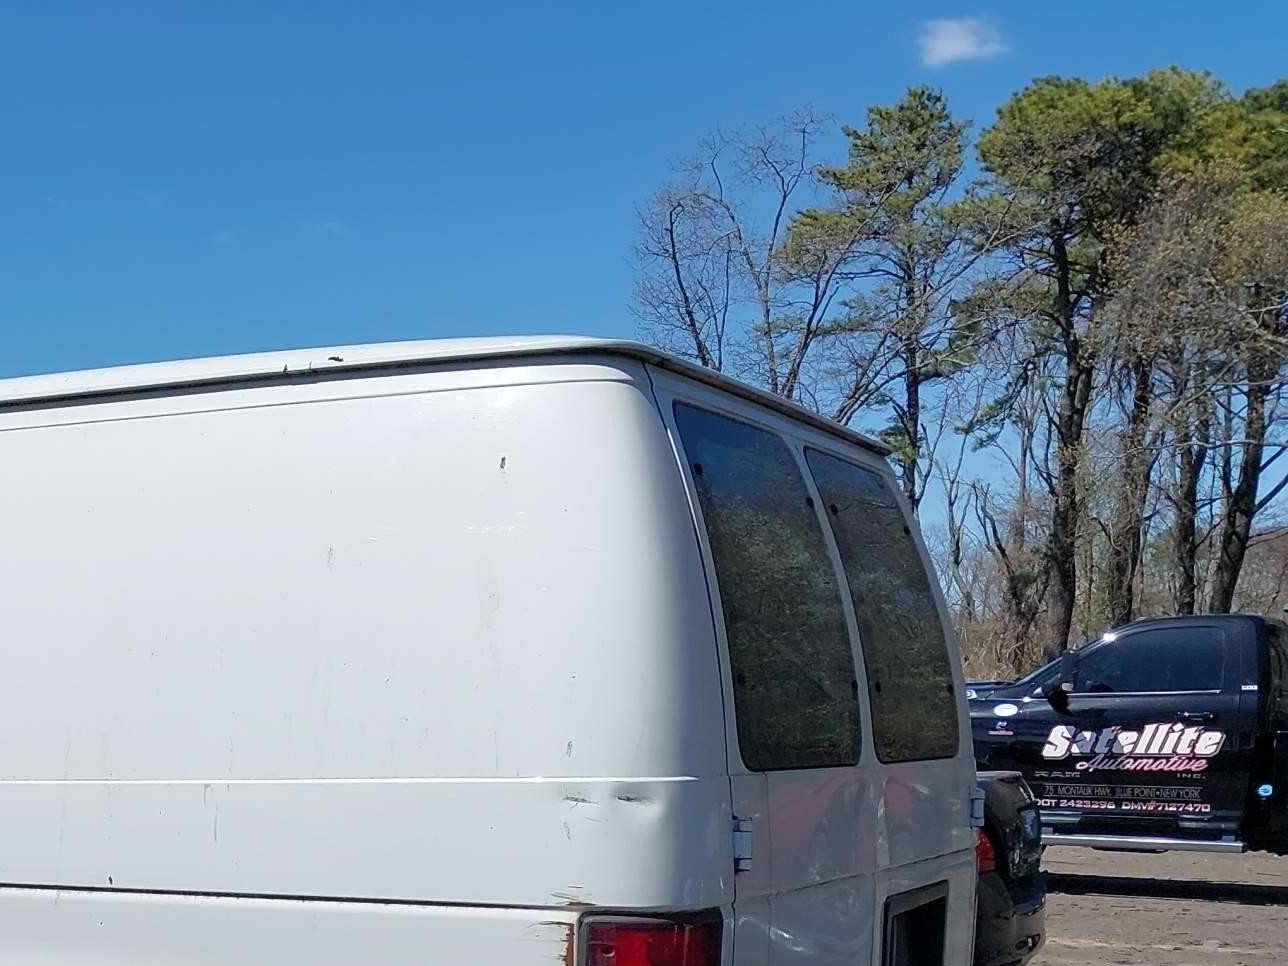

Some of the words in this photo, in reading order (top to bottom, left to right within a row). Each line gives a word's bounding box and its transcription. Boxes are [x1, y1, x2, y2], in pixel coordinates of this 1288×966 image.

[1040, 722, 1226, 759] Satellite
[1076, 754, 1208, 772] Automotive
[1057, 786, 1093, 796] MONTAUK
[1115, 787, 1133, 797] BLUE
[1178, 789, 1201, 799] YORK
